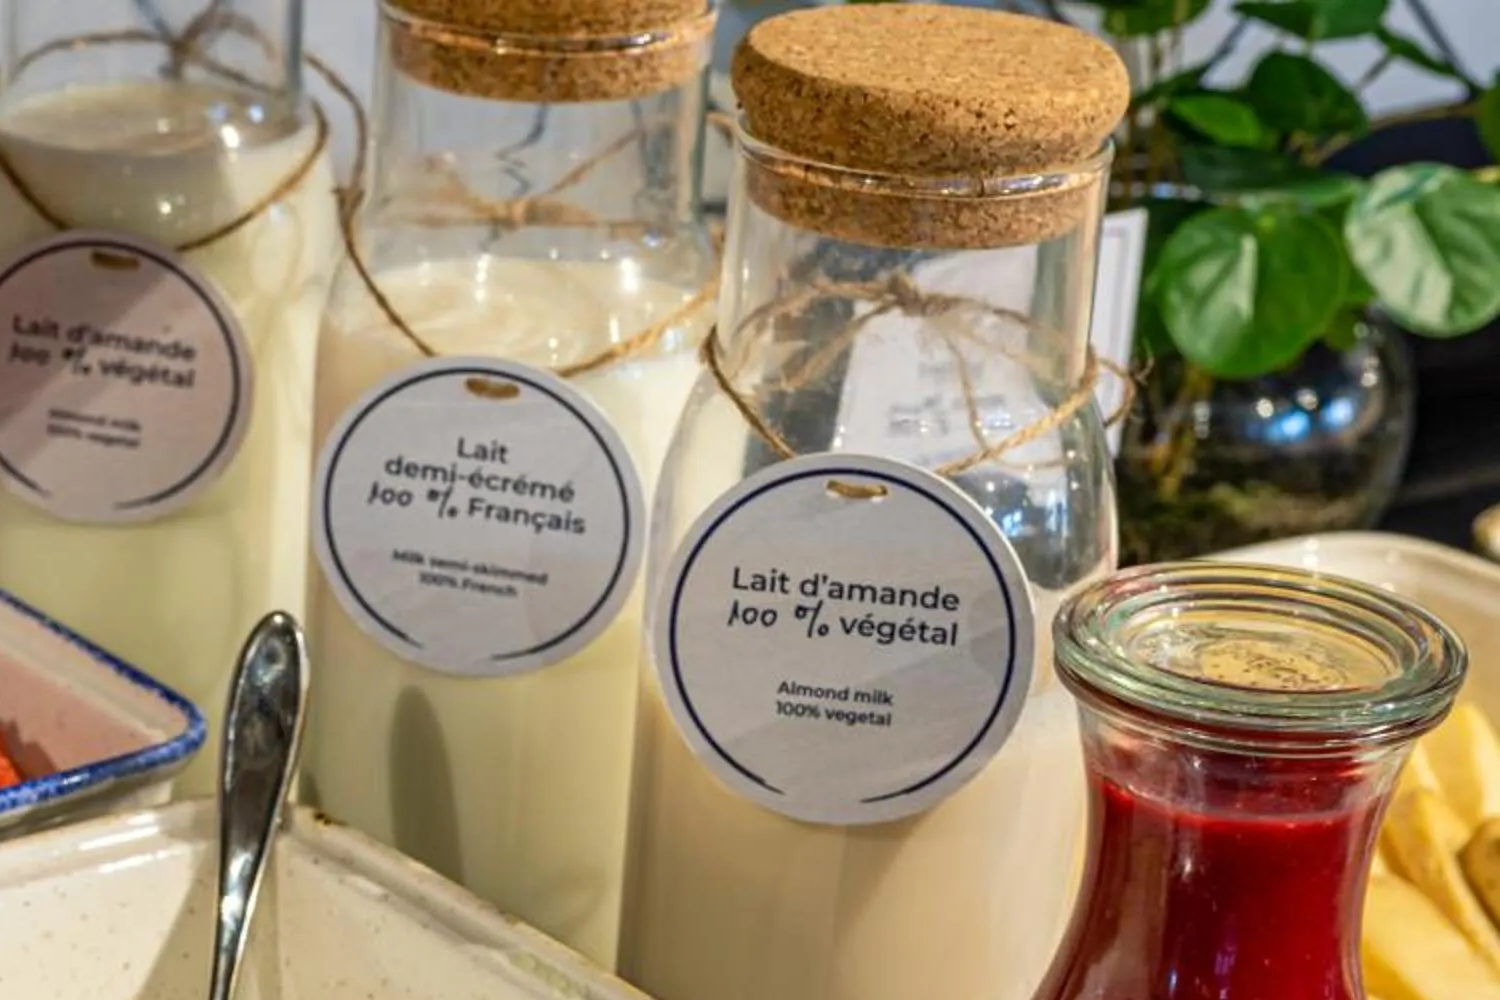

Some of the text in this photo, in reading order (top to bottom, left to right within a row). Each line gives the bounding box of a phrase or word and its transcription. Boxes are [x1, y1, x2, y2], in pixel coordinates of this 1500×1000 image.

[457, 437, 509, 464] Lait
[385, 456, 575, 503] demi-écrémé
[468, 497, 586, 534] Français
[732, 567, 960, 611] Lait d'amande
[839, 613, 958, 646] végétal
[777, 681, 893, 706] Almond milk
[776, 701, 892, 726] 100% vegetal
